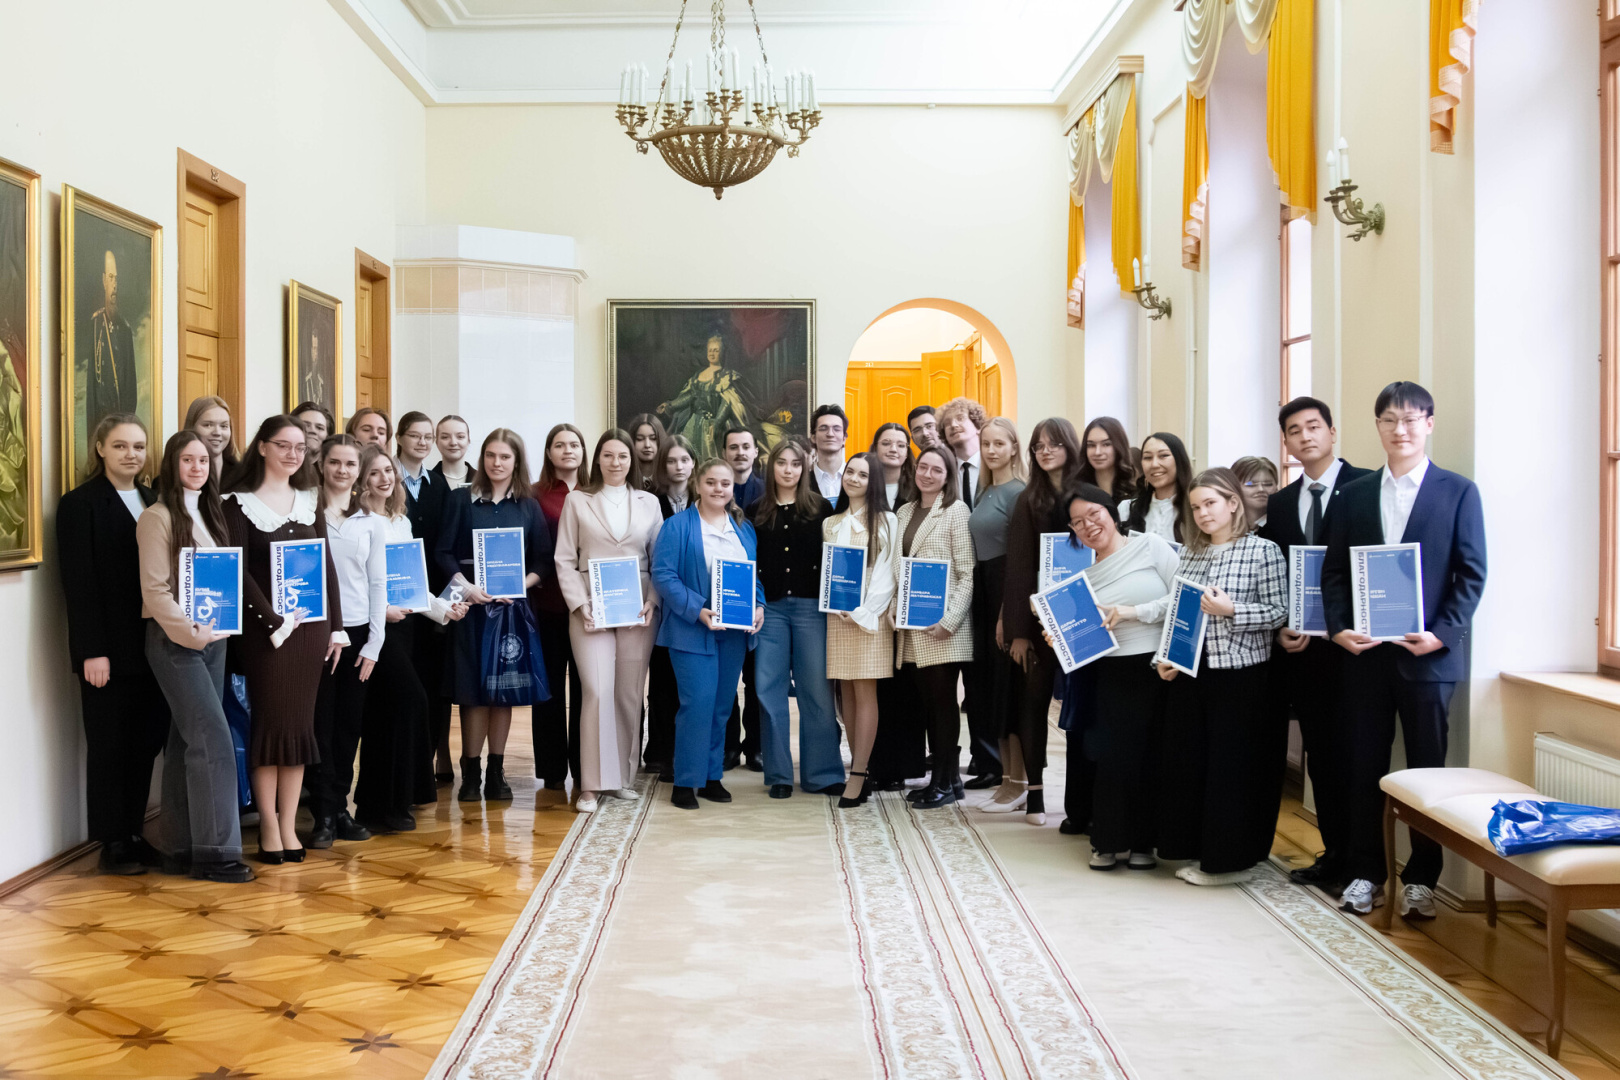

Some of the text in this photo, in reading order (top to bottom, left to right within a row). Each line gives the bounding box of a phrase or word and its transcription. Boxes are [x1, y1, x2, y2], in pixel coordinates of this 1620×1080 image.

[184, 552, 192, 619] БЛАГОДАРНОС
[477, 532, 485, 592] БЛАГОДАРНОСТ
[823, 545, 832, 609] БЛАГОДАРНОСТЬ
[900, 561, 910, 626] БЛАГОДАРНОСТЬ
[1038, 597, 1073, 668] БЛАГОДАРНОСТЬ
[1163, 581, 1181, 659] БЛАГОДАРНОСТЬ
